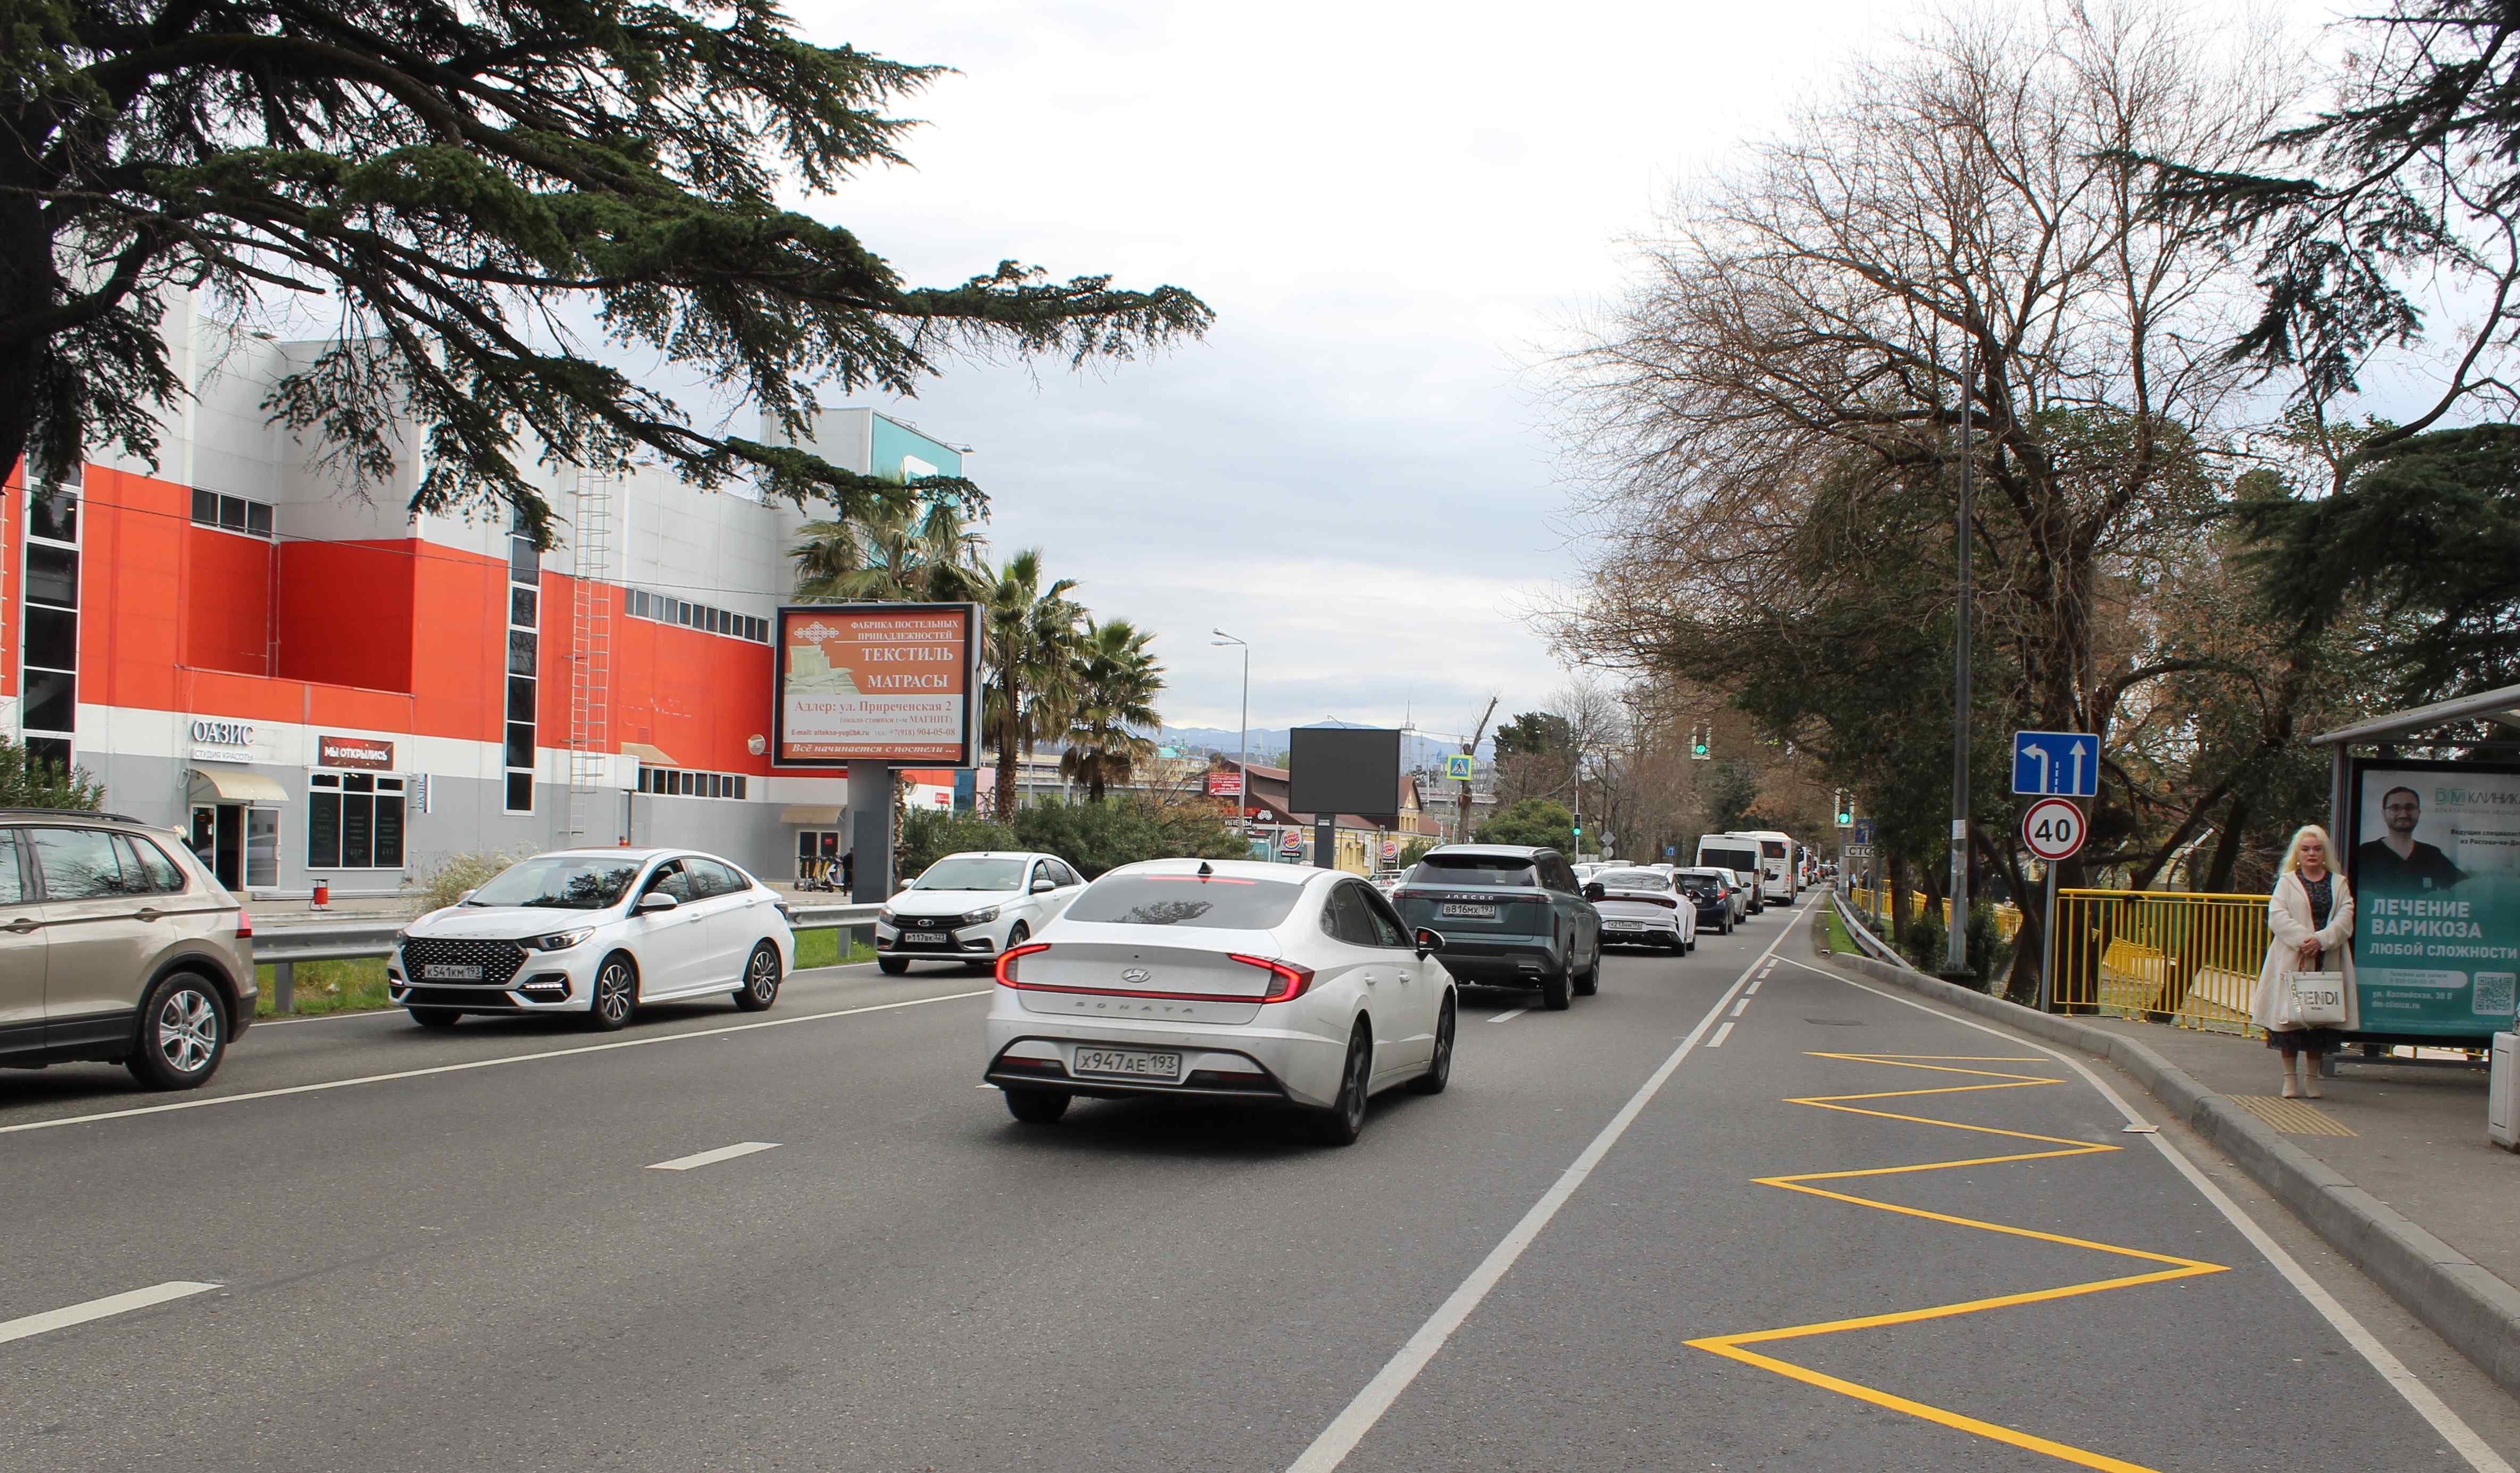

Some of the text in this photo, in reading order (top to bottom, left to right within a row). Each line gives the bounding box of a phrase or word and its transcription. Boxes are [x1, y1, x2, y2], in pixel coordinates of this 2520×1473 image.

[895, 620, 958, 629] ПОСТЕЛЬНЫХ
[858, 630, 953, 640] ПРИНАДЛЕЖНОСТЕЙ
[862, 647, 954, 662] ТЕКСТИЛЬ
[868, 674, 949, 688] МАТРАСЫ
[794, 701, 952, 714] Адлер: ул. Приреченская 2
[193, 720, 255, 745] ОАЗИС
[325, 746, 388, 761] МЫ ОТКРЫЛИСЬ
[792, 743, 812, 753] Всё
[814, 745, 883, 753] начинается
[195, 750, 254, 761] СТУДИЯ КРАСОТЫ
[2468, 792, 2520, 805] КЛИНИК
[2034, 819, 2071, 842] 40
[2371, 898, 2470, 918] ЛЕЧЕНИЕ
[2371, 919, 2482, 939] ВАРИКОЗА
[2369, 941, 2518, 959] ЛЮБОЙ СЛОЖНОСТИ
[2297, 991, 2339, 1006] FENDI
[1075, 1001, 1194, 1014] SONATA
